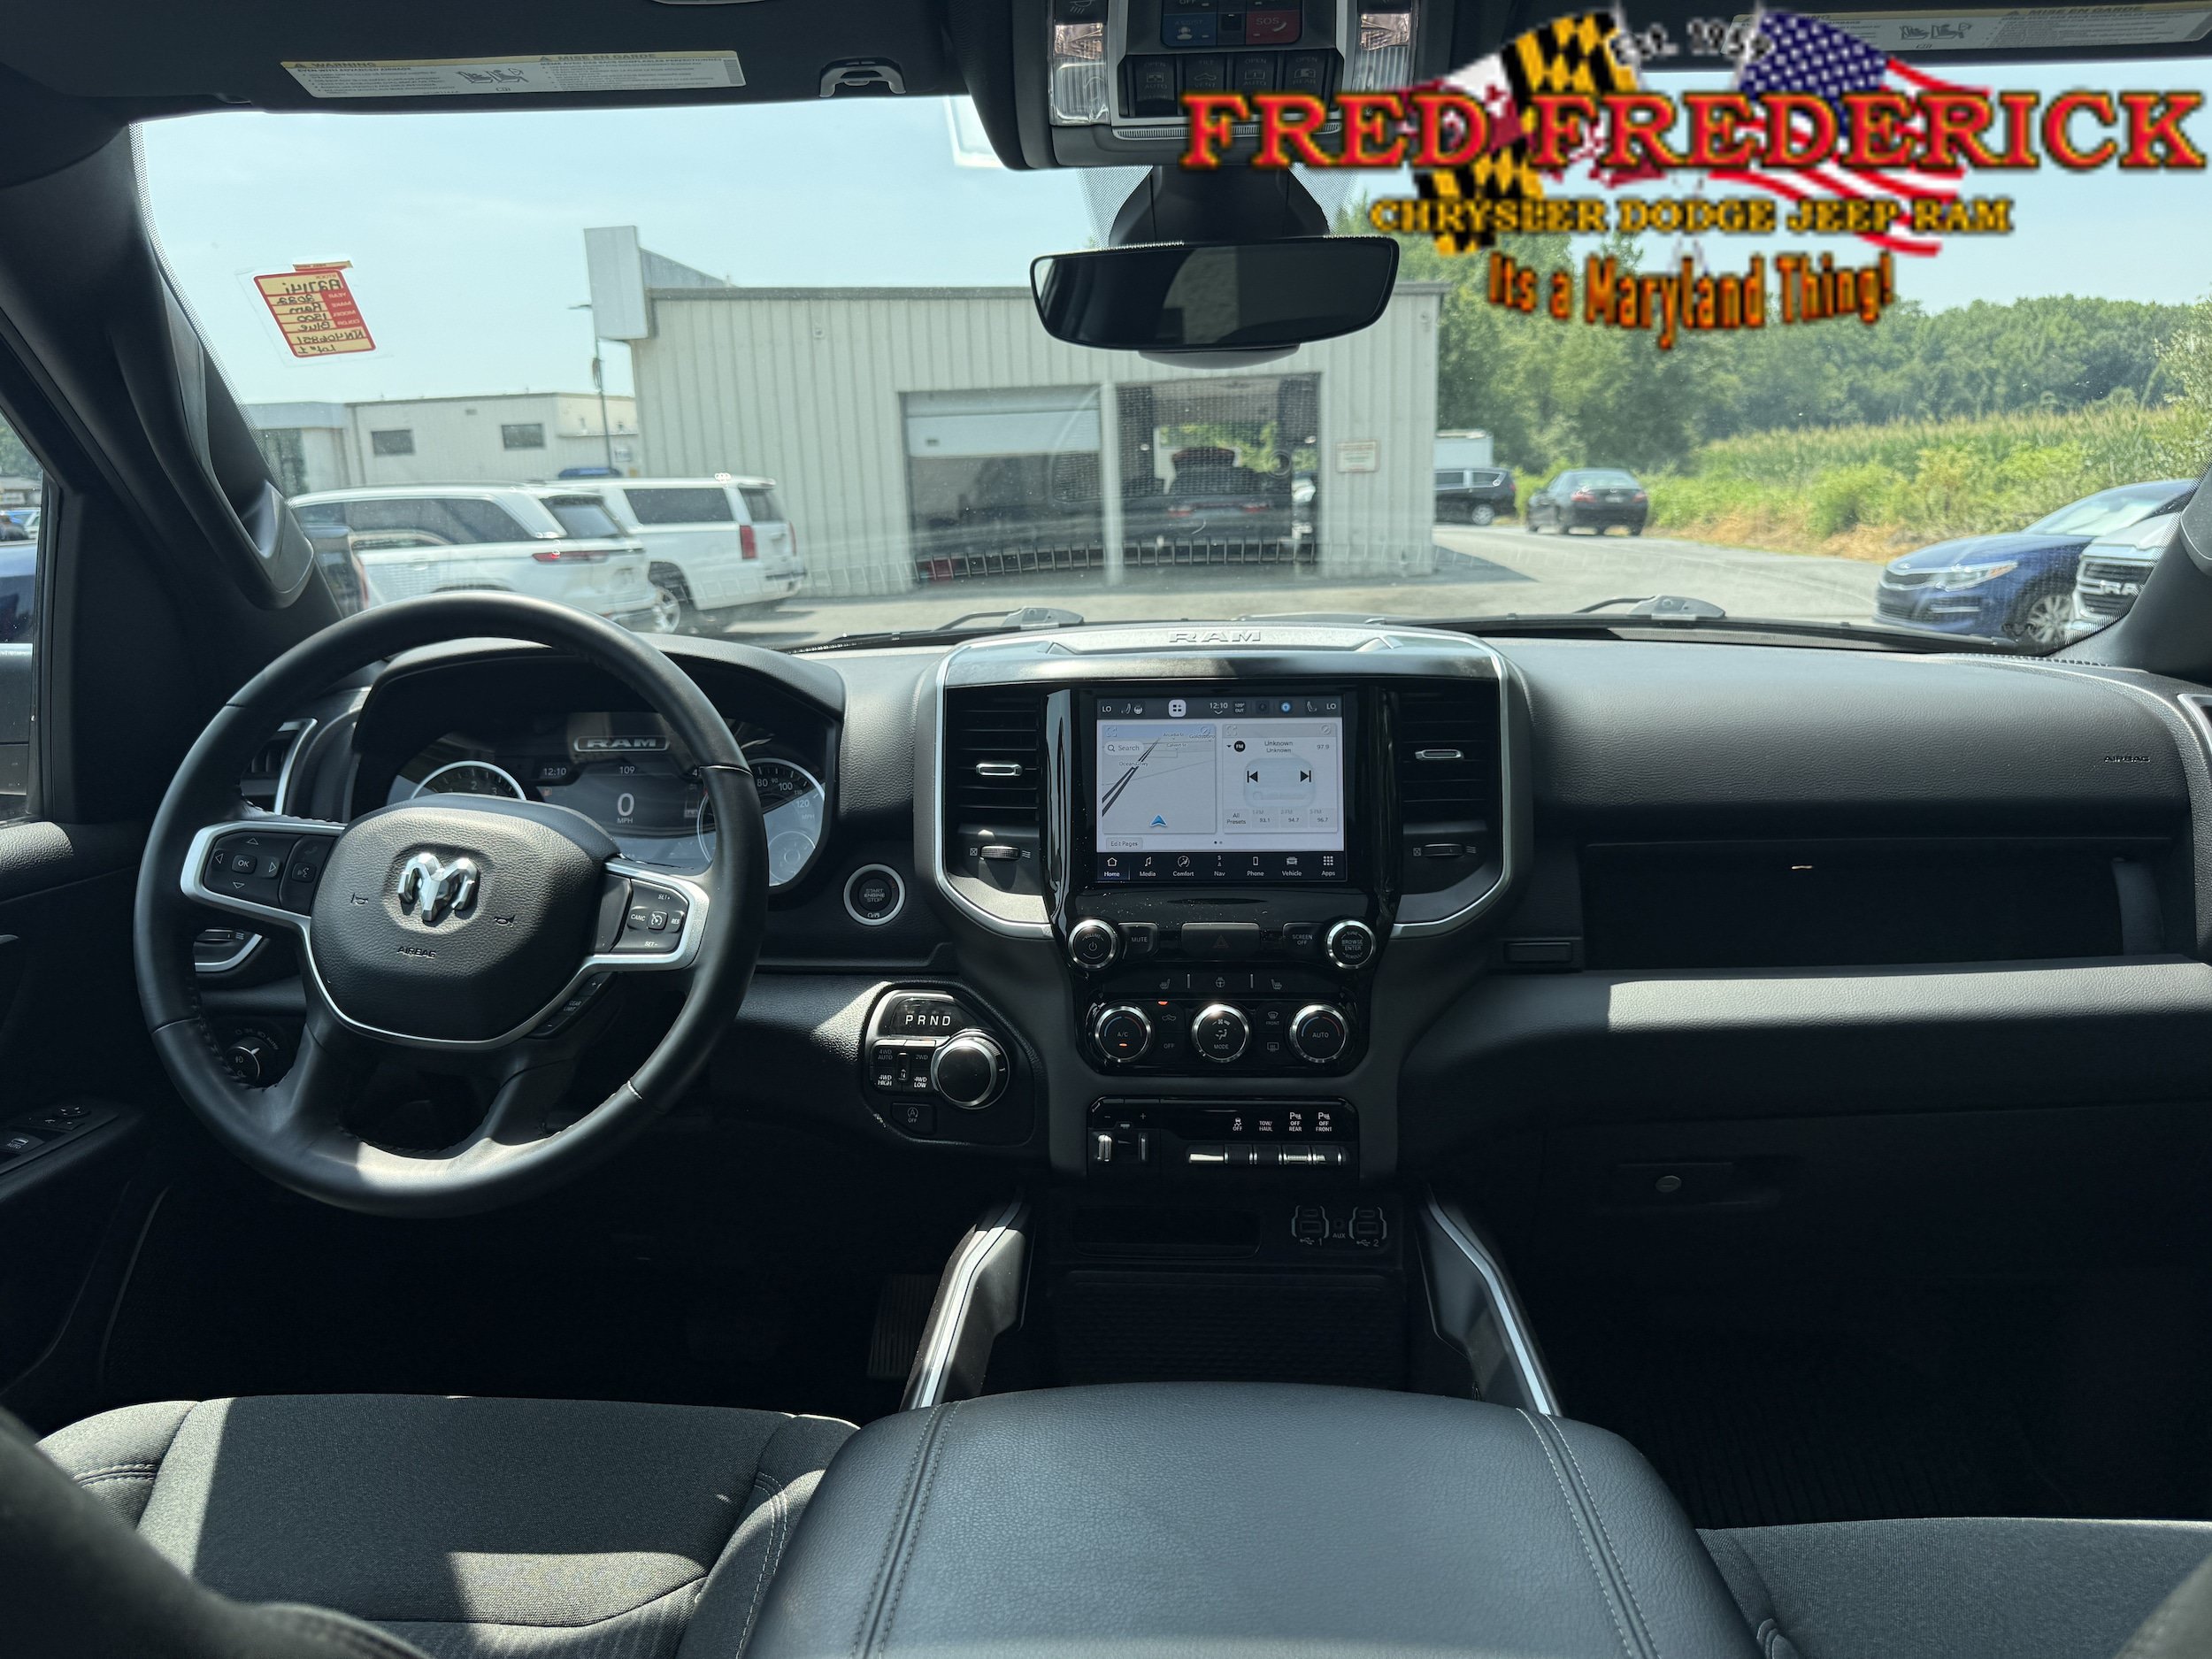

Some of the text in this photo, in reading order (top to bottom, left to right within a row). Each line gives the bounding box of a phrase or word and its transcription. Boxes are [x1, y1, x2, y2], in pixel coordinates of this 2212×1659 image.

[1255, 17, 1280, 26] SOS
[1169, 629, 1263, 643] RAM
[587, 738, 657, 748] RAM
[2103, 755, 2151, 764] AIRBAG
[542, 767, 567, 776] 12:10
[618, 765, 635, 775] 109
[470, 780, 478, 791] 2
[757, 779, 769, 787] 80
[779, 781, 794, 792] 100
[617, 792, 635, 817] 0
[796, 798, 810, 809] 120
[236, 859, 250, 868] OK
[630, 913, 646, 922] CANC
[396, 946, 437, 959] AIRBAG
[1372, 1239, 1380, 1248] 2
